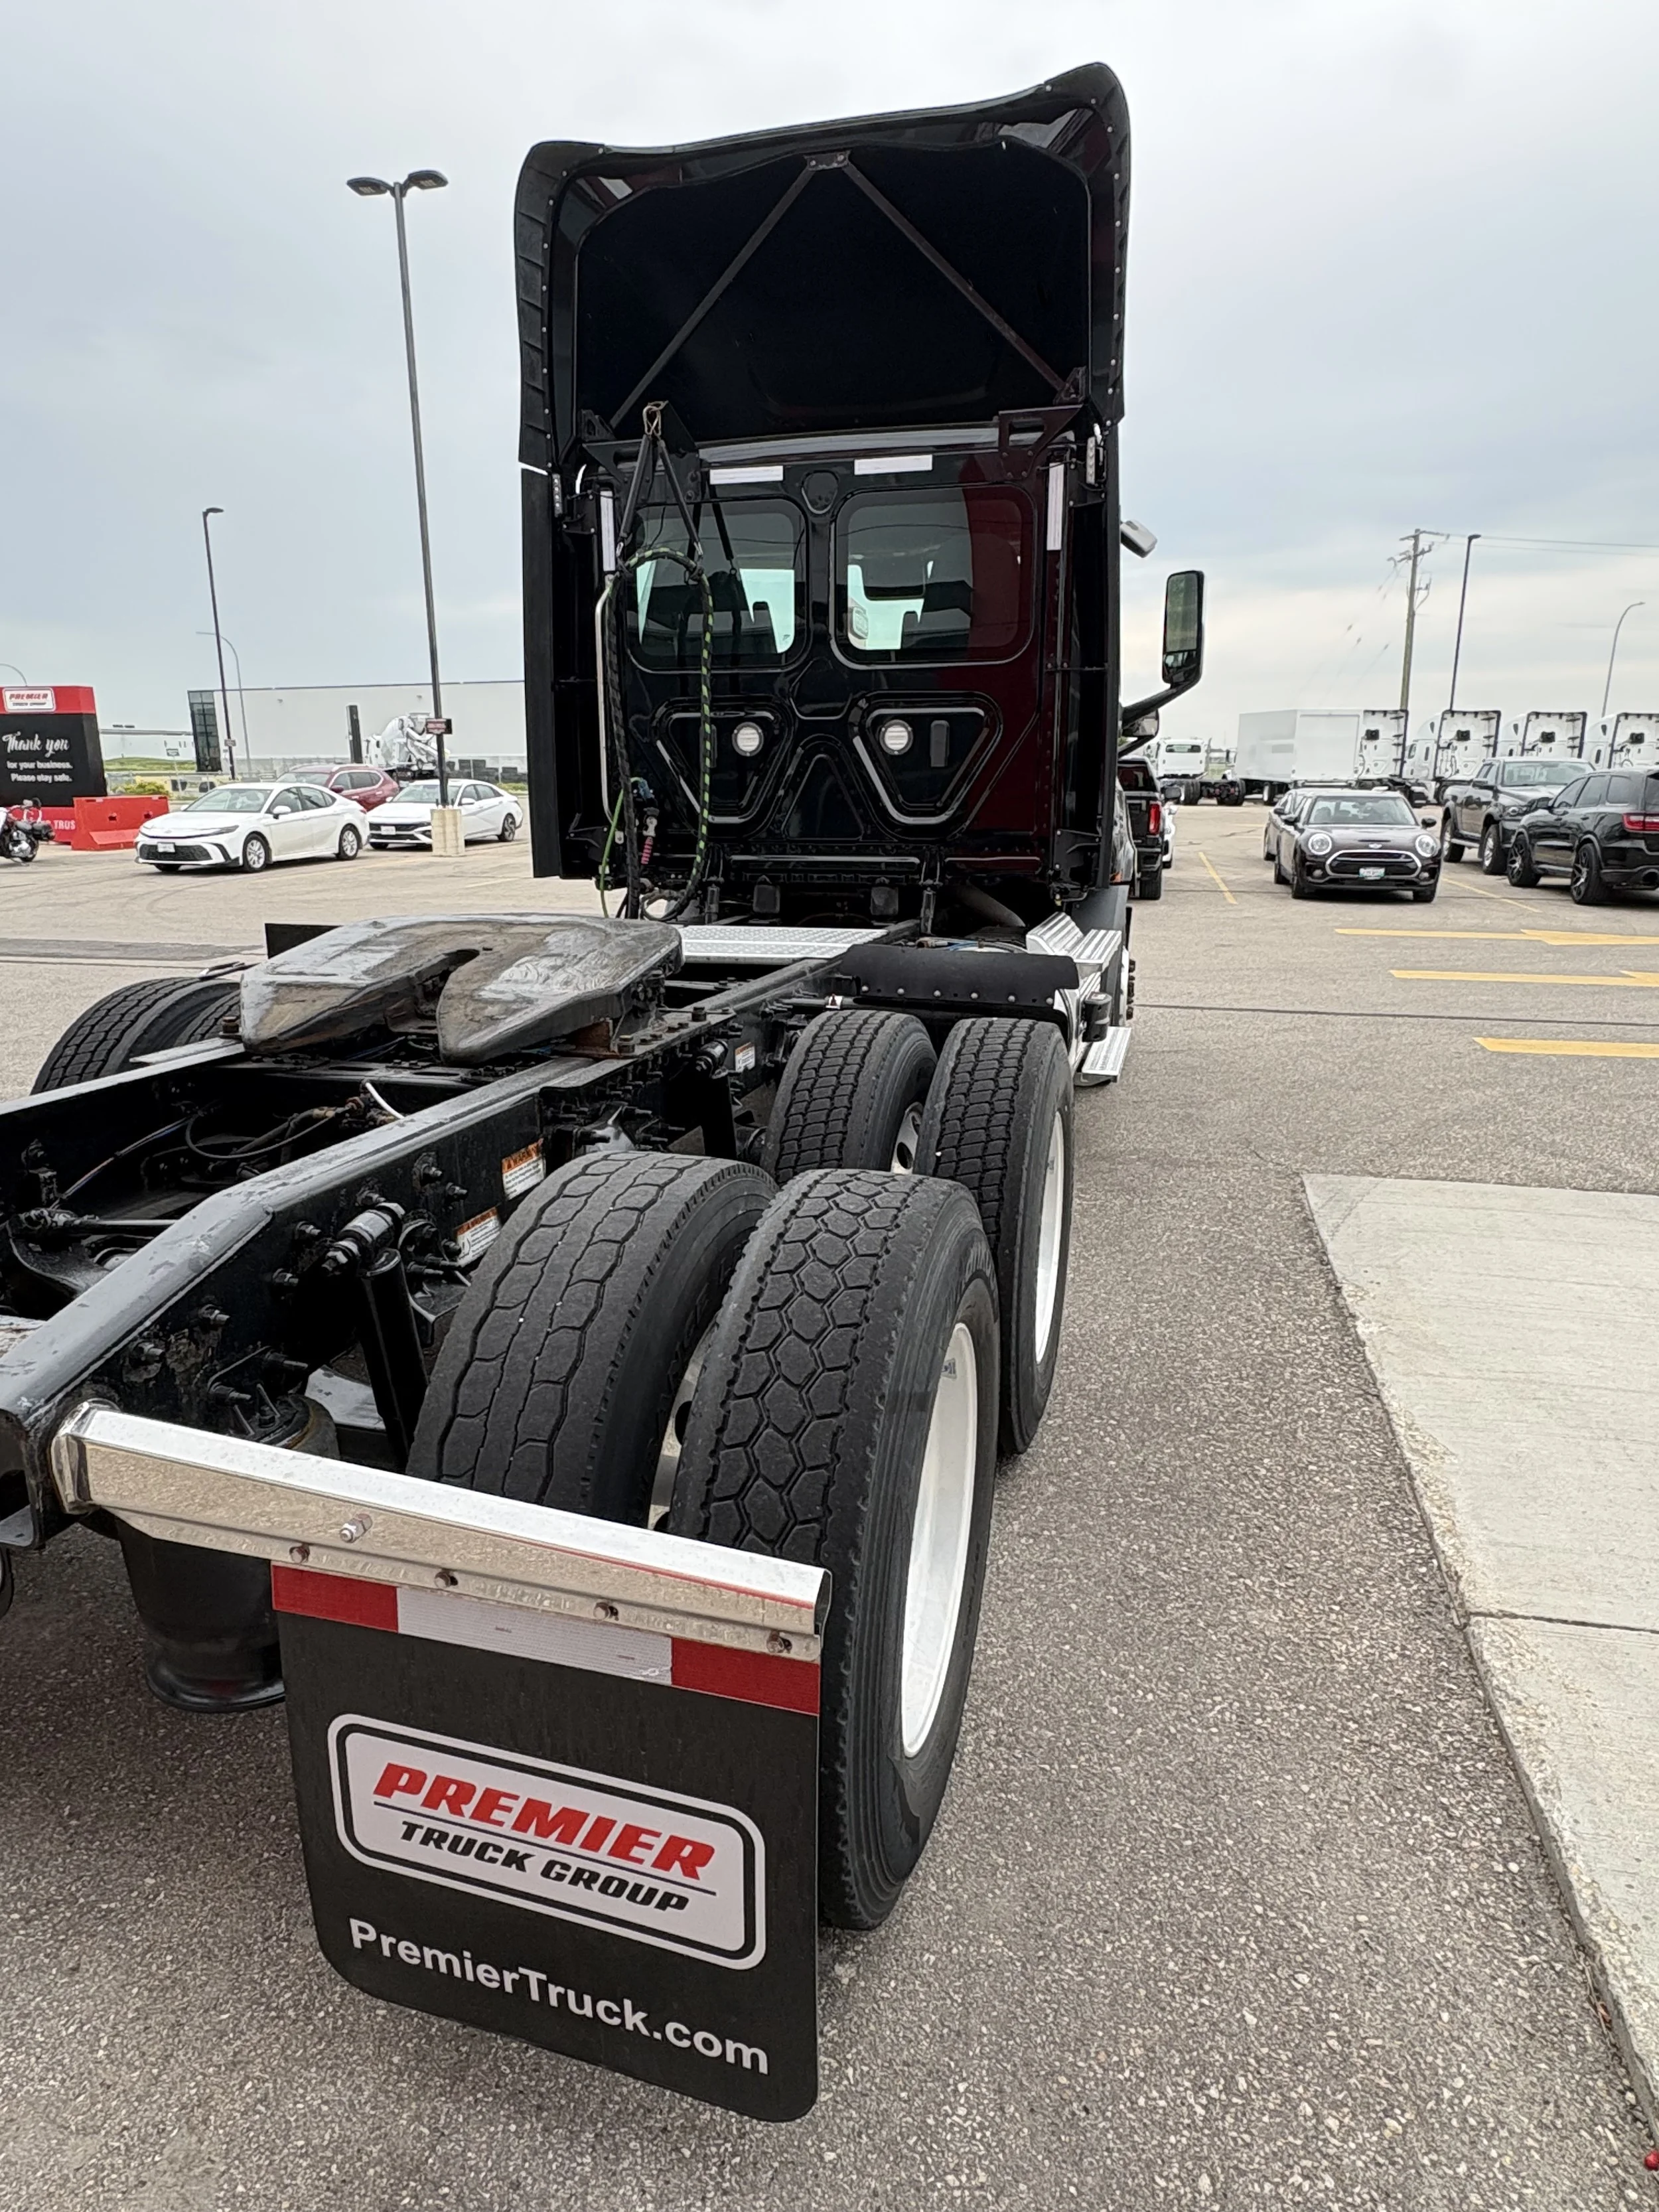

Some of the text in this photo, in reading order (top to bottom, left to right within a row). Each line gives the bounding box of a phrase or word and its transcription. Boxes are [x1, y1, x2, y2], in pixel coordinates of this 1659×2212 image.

[2, 731, 70, 758] Thank you
[19, 761, 36, 771] your
[36, 760, 73, 769] business.
[11, 773, 36, 782] Please
[36, 773, 52, 783] stay
[374, 1763, 715, 1880] PREMIER
[401, 1820, 689, 1912] TRUCK GROUP
[349, 1918, 768, 2075] PremierTruck.com
